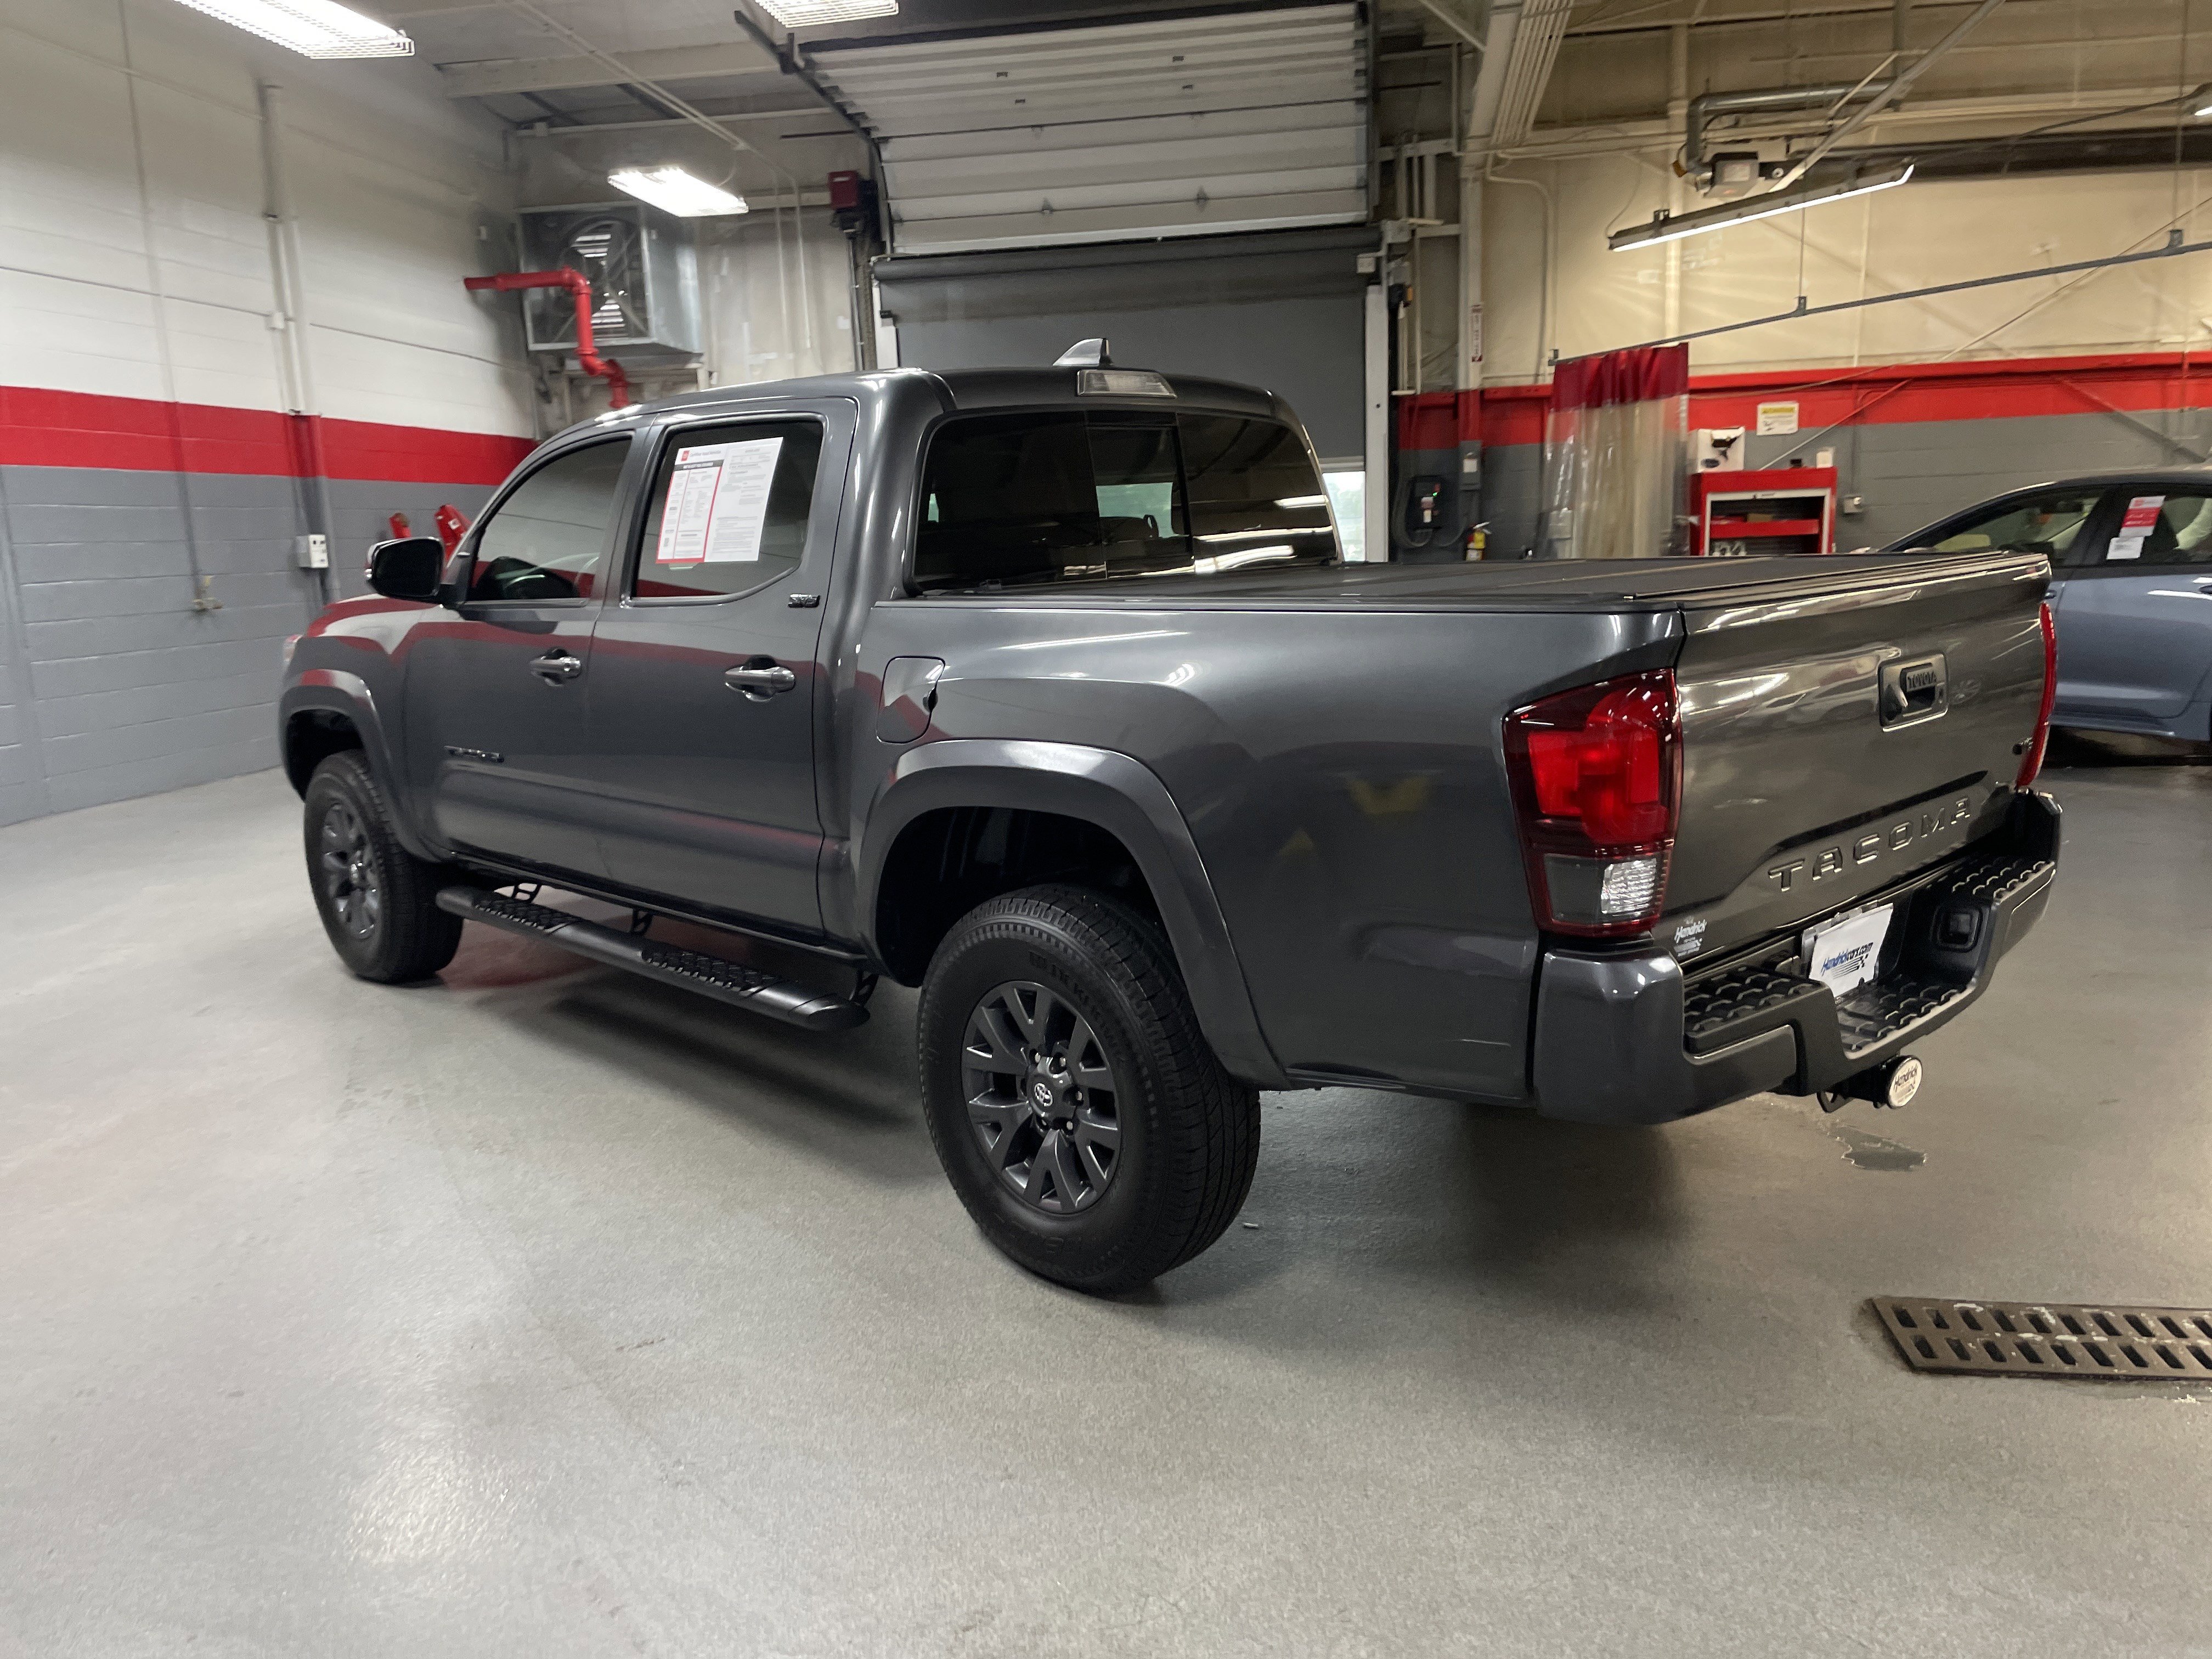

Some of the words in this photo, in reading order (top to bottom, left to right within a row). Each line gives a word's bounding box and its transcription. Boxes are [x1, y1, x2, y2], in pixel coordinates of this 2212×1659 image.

[1768, 798, 1971, 891] TACOMA
[1674, 919, 1707, 943] Hendrick
[1820, 942, 1874, 977] Hendrickcars.com
[1893, 1063, 1918, 1093] Hendrick
